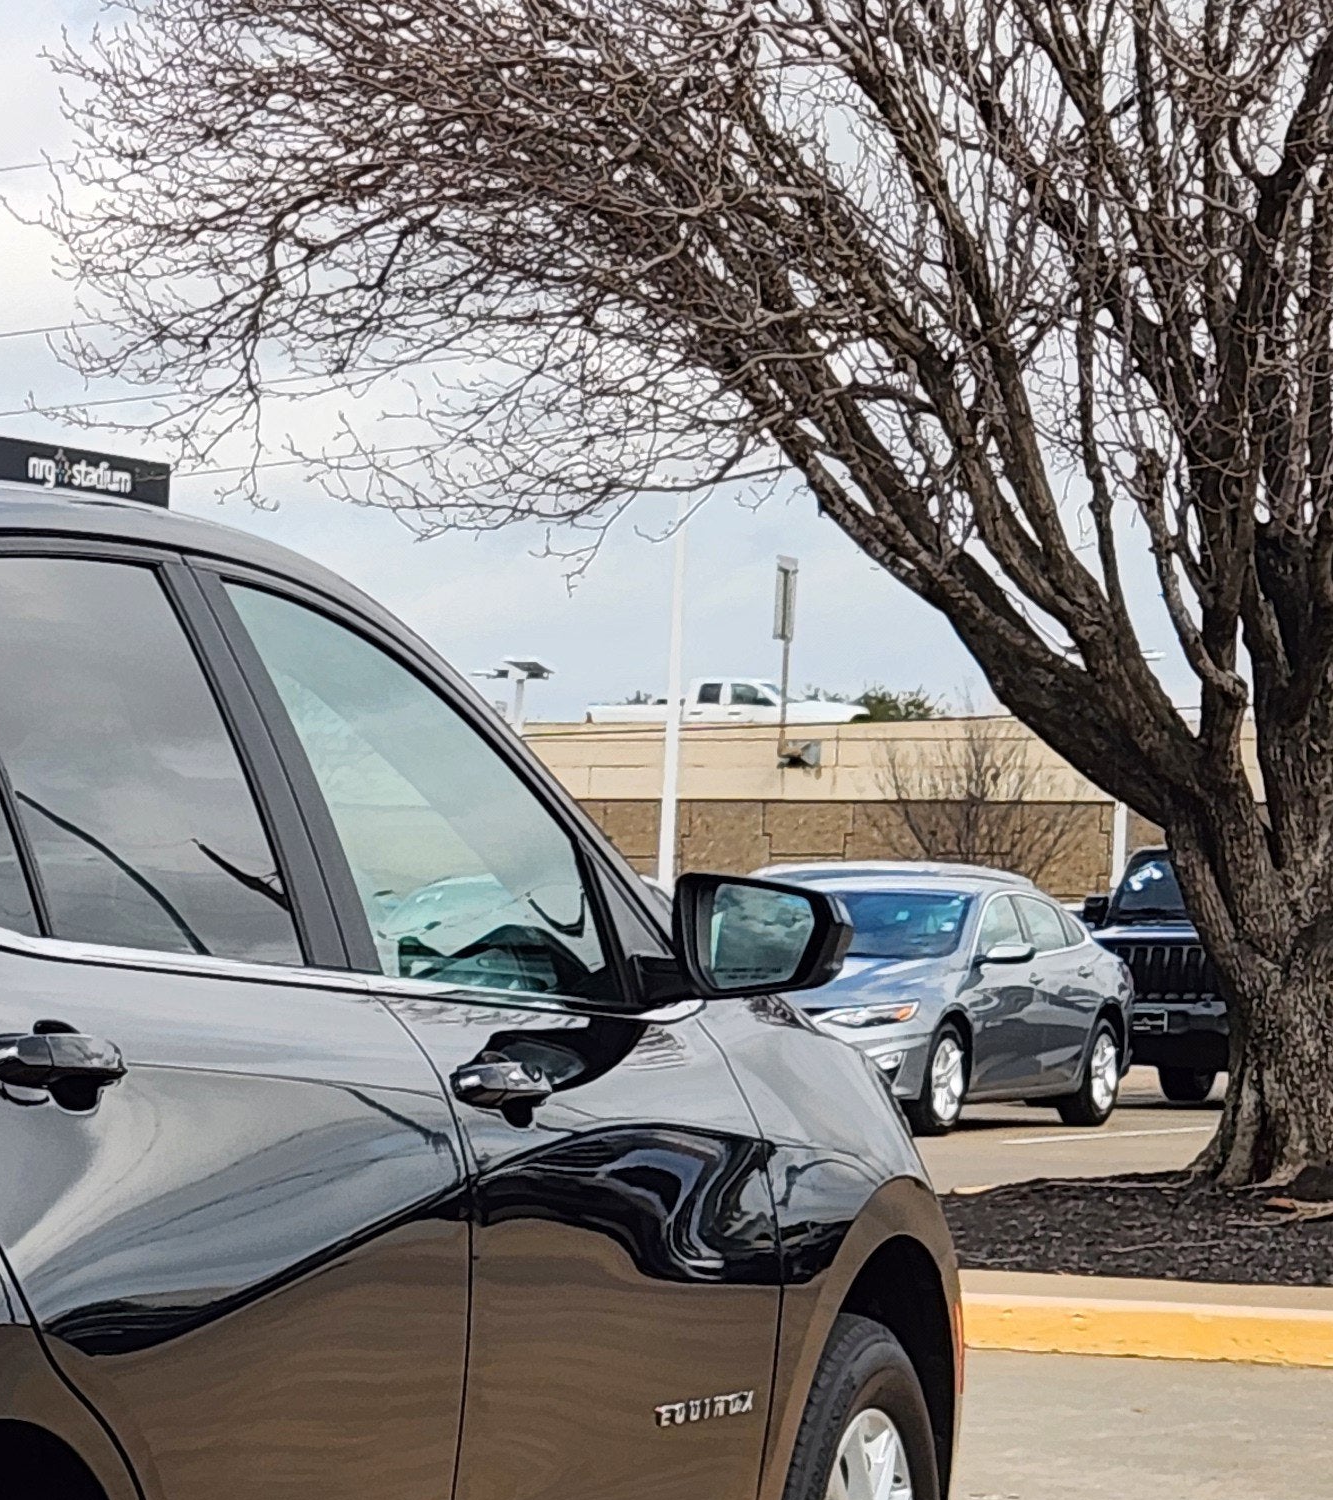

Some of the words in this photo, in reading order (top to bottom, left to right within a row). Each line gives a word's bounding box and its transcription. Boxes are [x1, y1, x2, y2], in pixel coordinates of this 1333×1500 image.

[28, 456, 55, 489] nrg
[71, 459, 132, 493] stadium
[654, 1390, 754, 1427] EQUINOX
